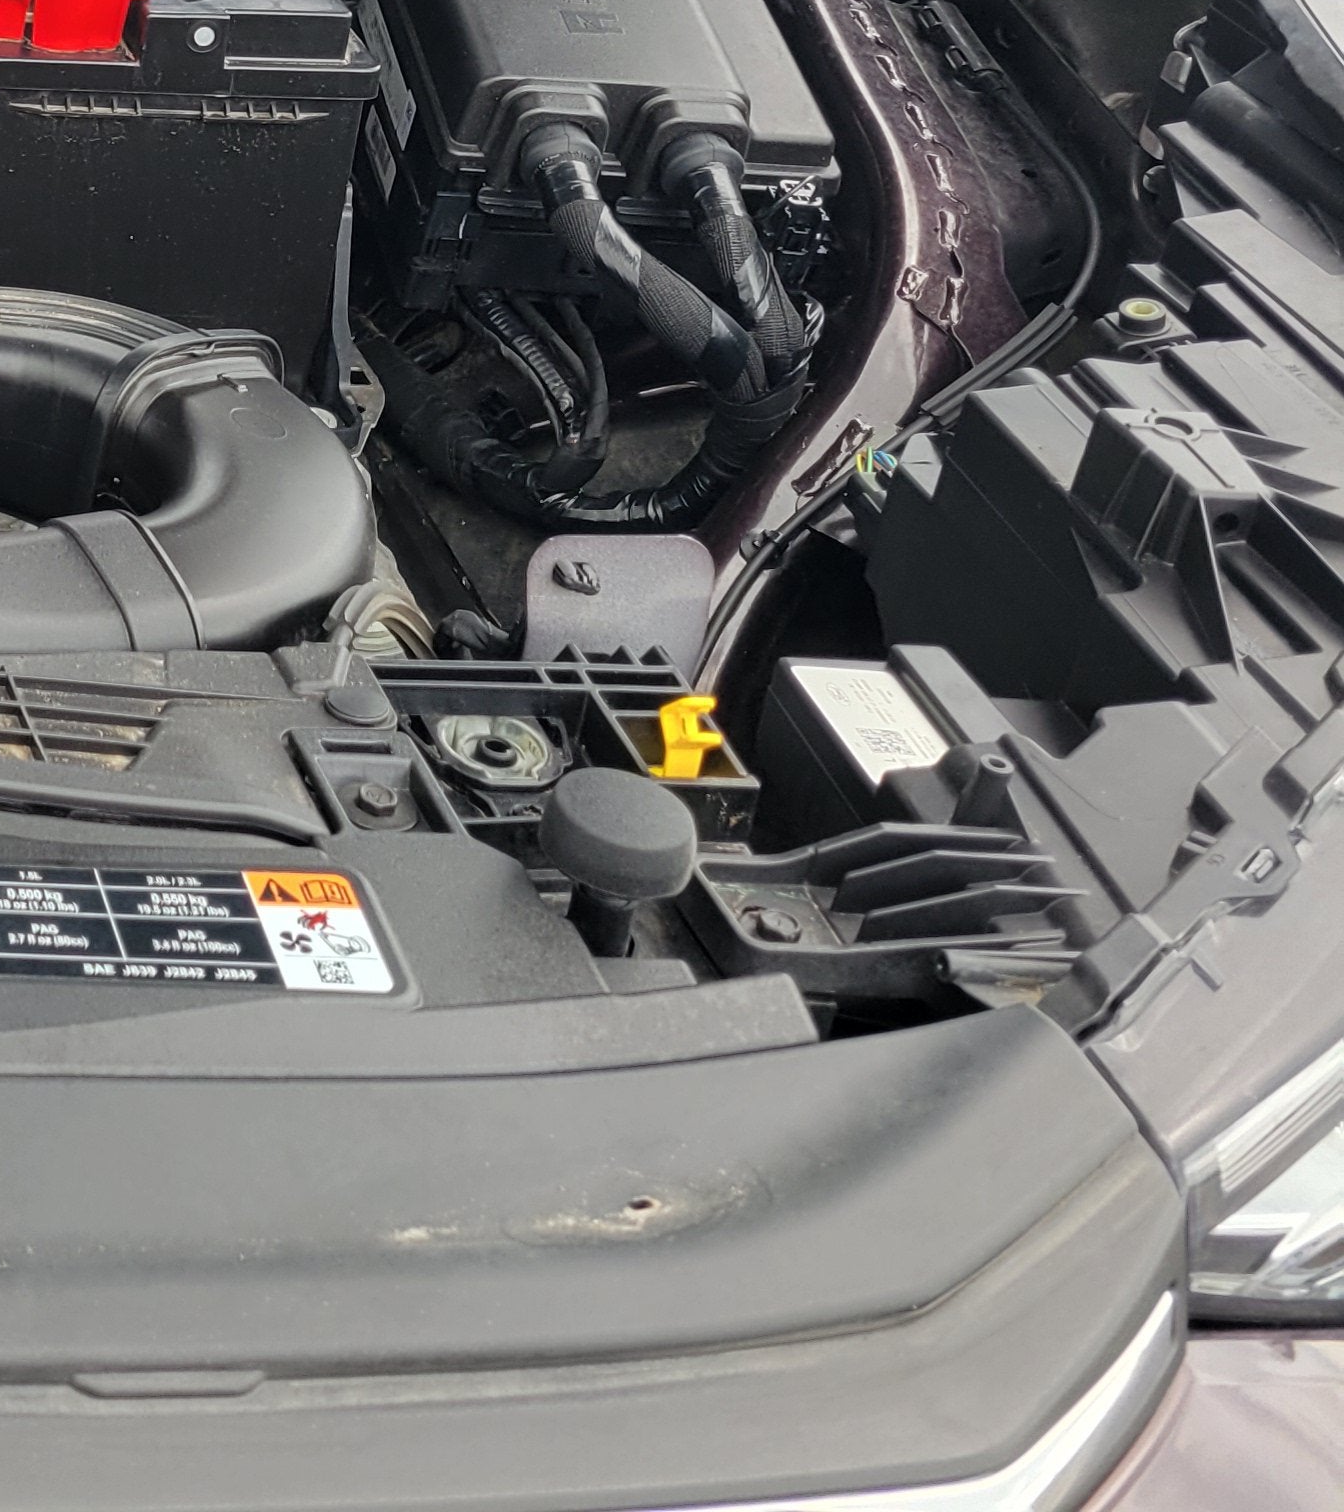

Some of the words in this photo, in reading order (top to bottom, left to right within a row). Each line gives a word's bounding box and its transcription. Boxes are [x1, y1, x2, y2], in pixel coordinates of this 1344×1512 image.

[44, 889, 63, 904] kg
[188, 893, 208, 907] kg
[31, 923, 59, 935] PAG
[177, 929, 206, 941] PAG
